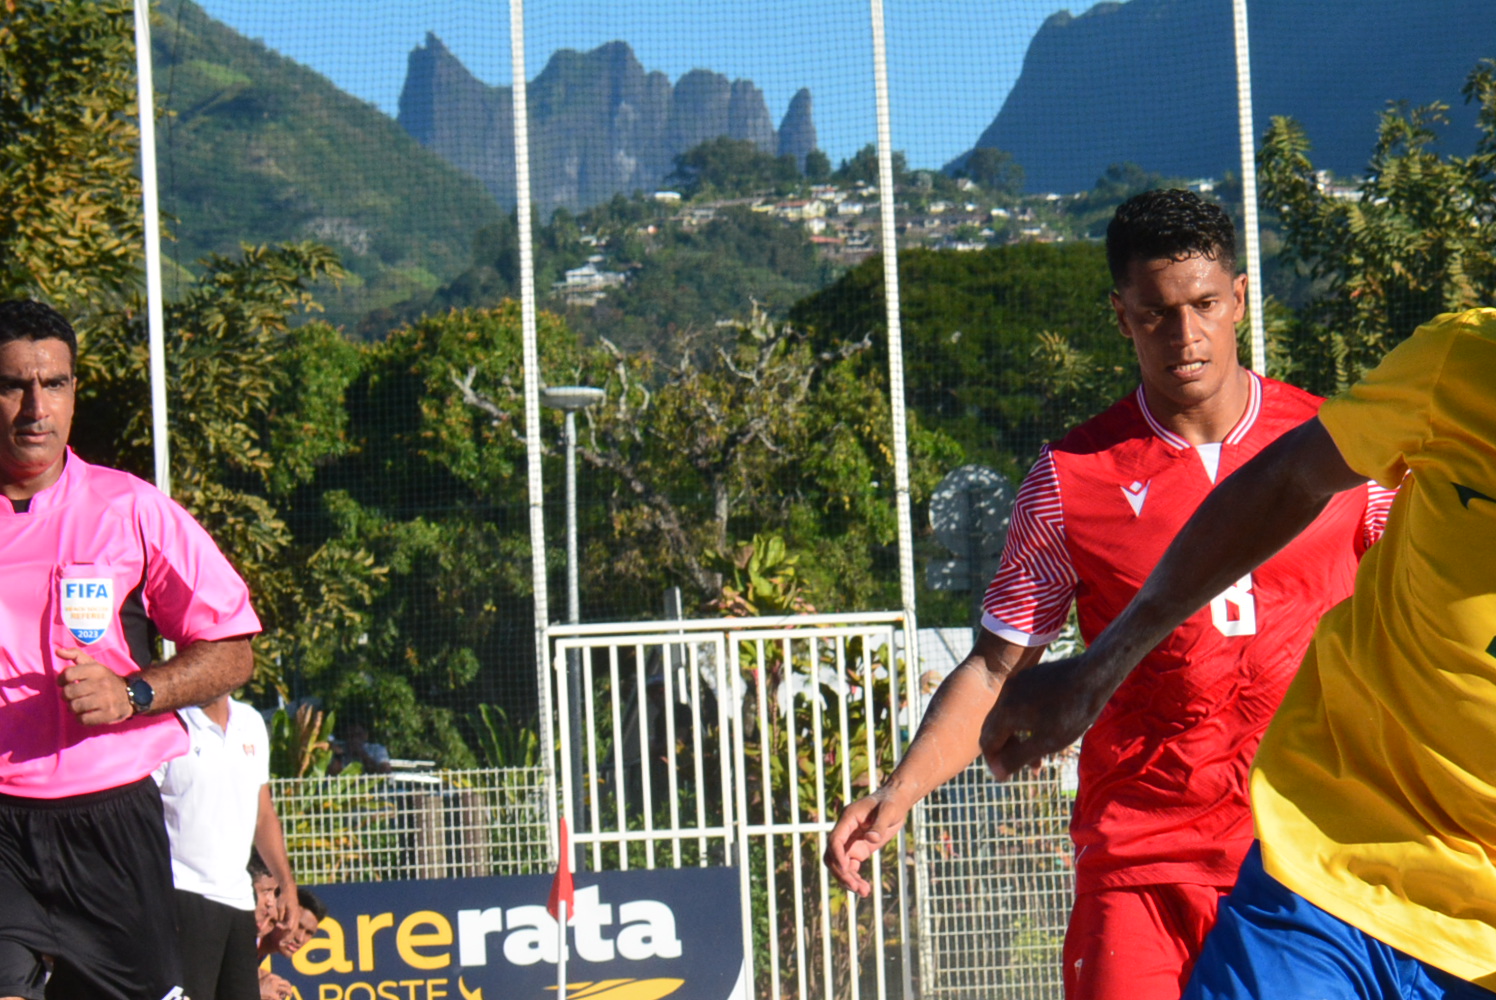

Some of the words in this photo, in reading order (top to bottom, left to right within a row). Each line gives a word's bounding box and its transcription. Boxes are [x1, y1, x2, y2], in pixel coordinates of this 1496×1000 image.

[66, 583, 108, 598] FIFA
[77, 630, 98, 638] 2023
[260, 884, 682, 975] arerata
